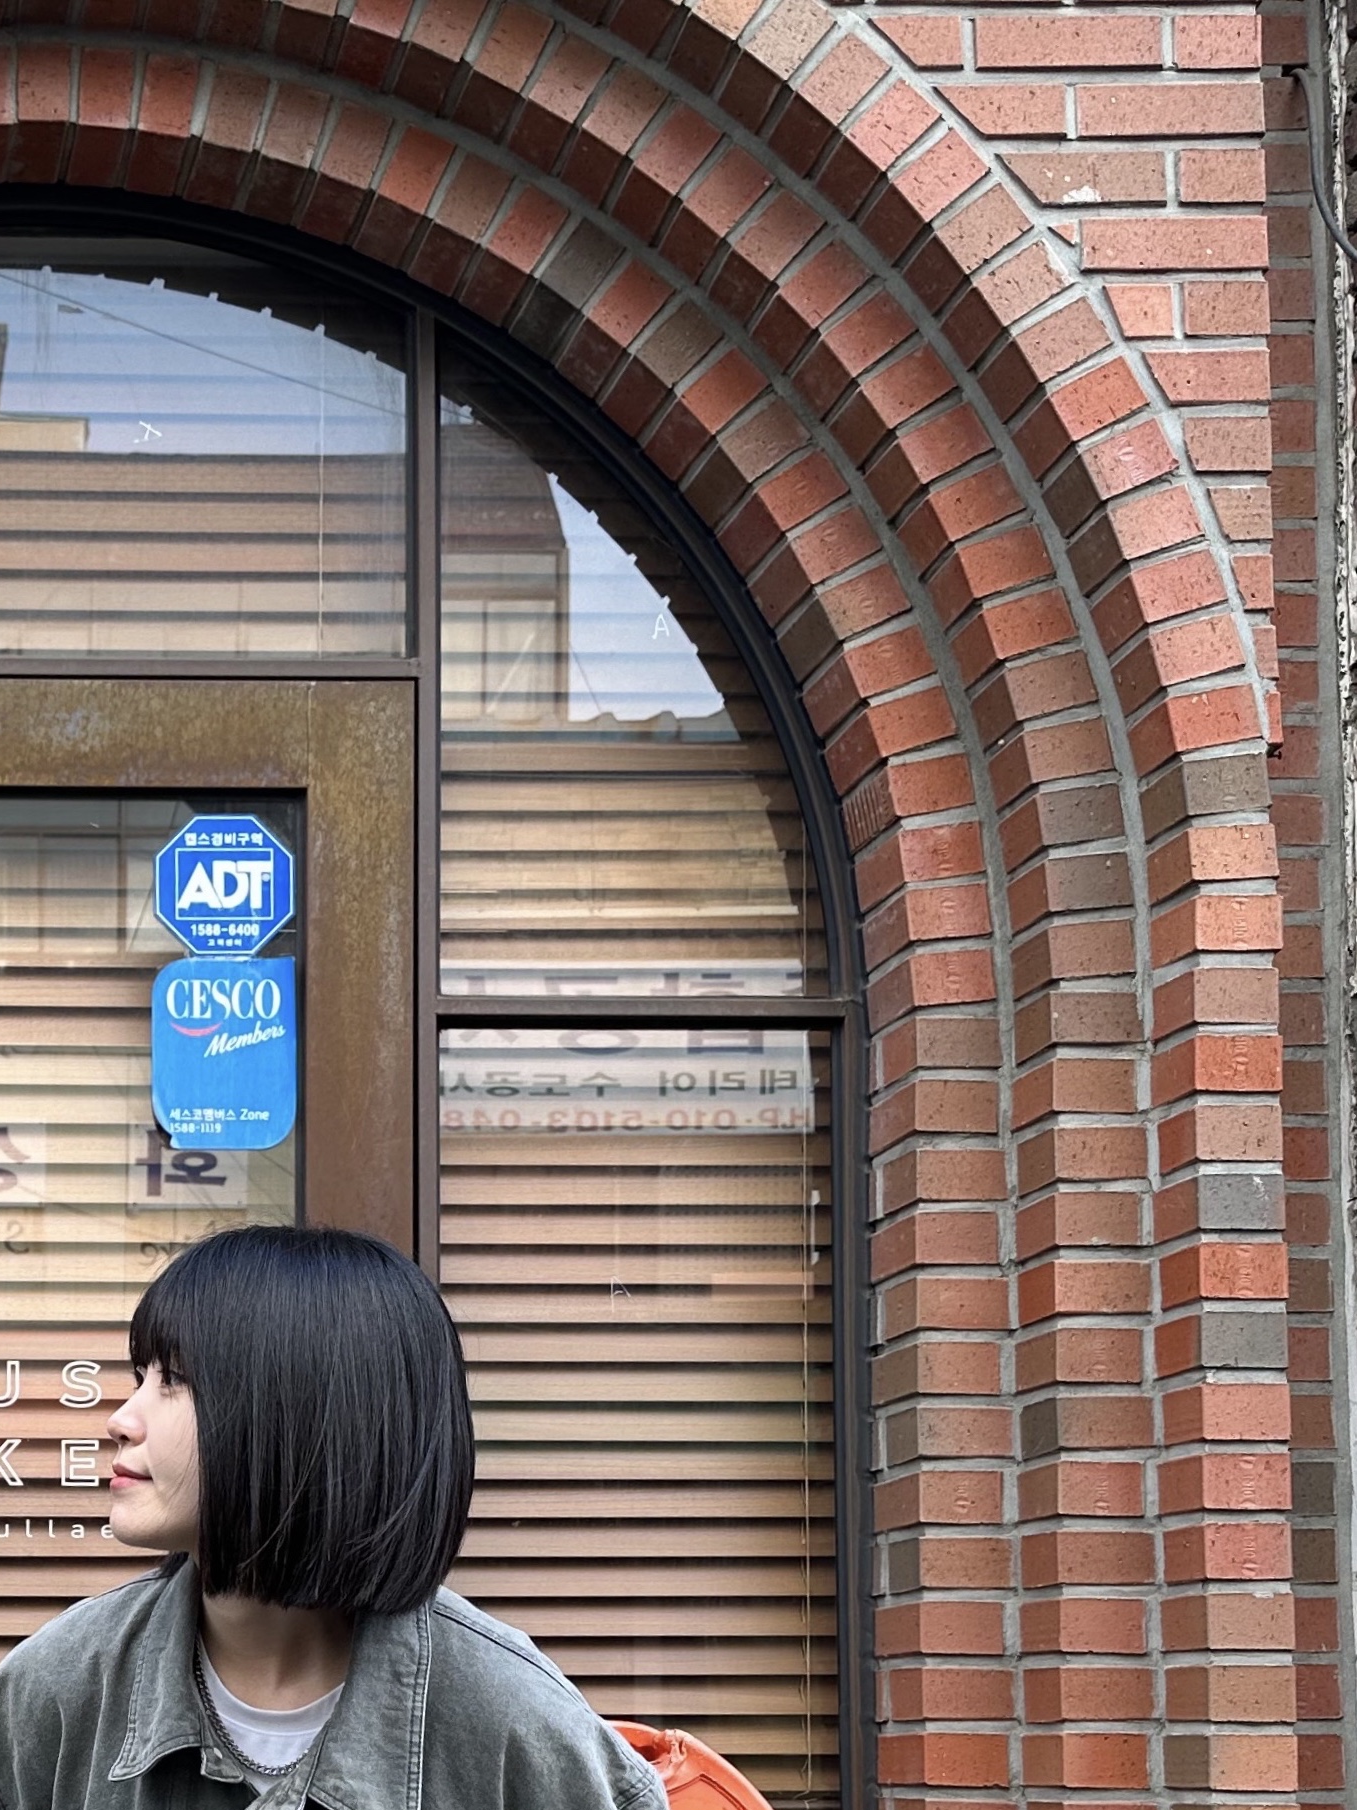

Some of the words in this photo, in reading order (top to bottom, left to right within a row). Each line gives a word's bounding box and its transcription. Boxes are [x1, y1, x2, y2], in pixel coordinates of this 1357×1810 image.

[178, 860, 273, 909] ADT
[190, 923, 260, 937] 1588-6400
[166, 978, 282, 1021] CESCO
[204, 1020, 287, 1058] Members
[169, 1108, 236, 1121] 세스코멤버스
[239, 1108, 270, 1121] Zone
[169, 1123, 222, 1133] 1588-1119
